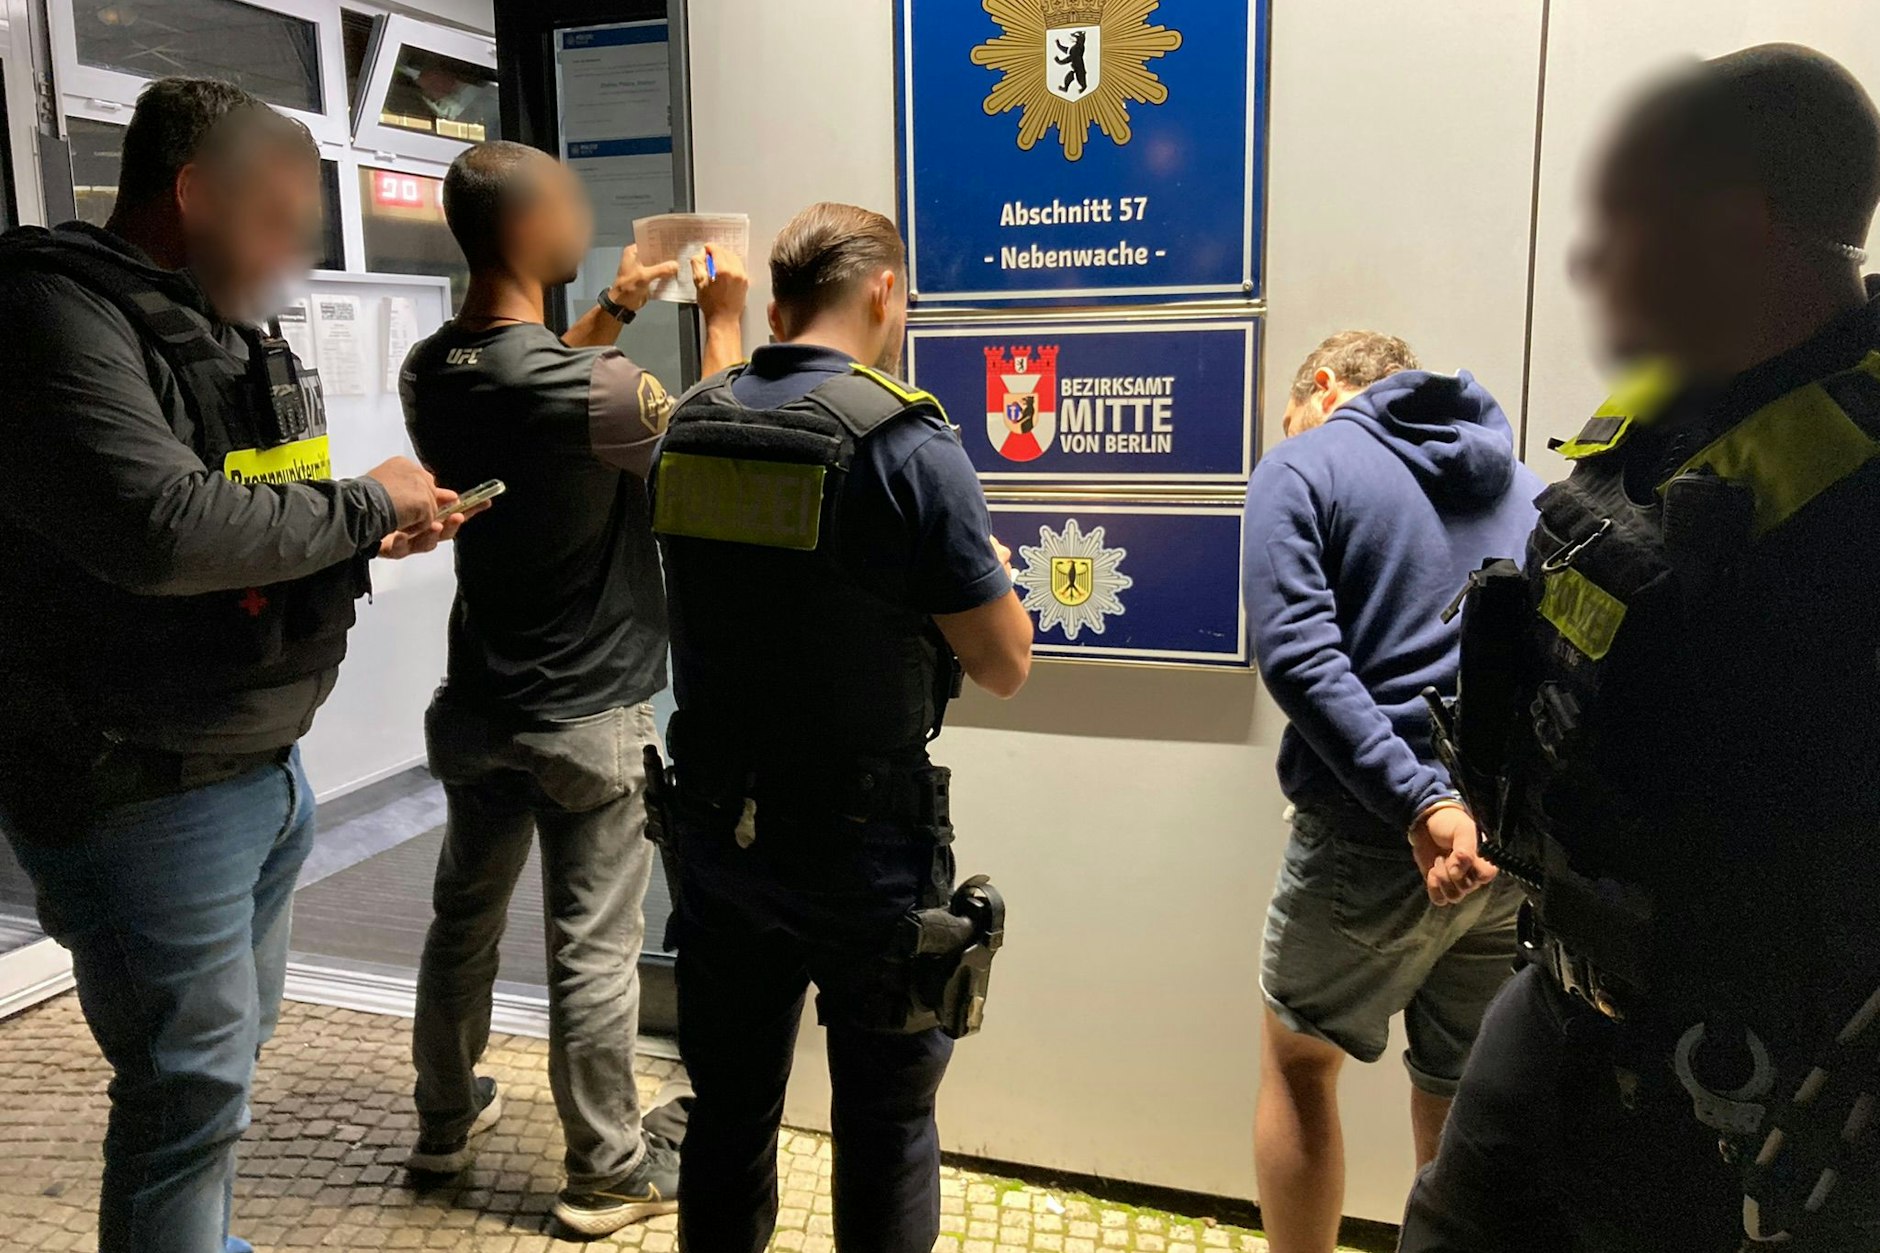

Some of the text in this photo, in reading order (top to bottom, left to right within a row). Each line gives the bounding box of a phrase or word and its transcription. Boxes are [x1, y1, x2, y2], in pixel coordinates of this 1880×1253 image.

[1000, 197, 1148, 227] Abschnitt 57
[1001, 241, 1149, 270] Nebenwache
[446, 348, 483, 365] UFC
[1061, 377, 1175, 397] BEZIRKSAMT
[1060, 397, 1173, 433] MITTE
[1060, 433, 1172, 454] VON BERLIN
